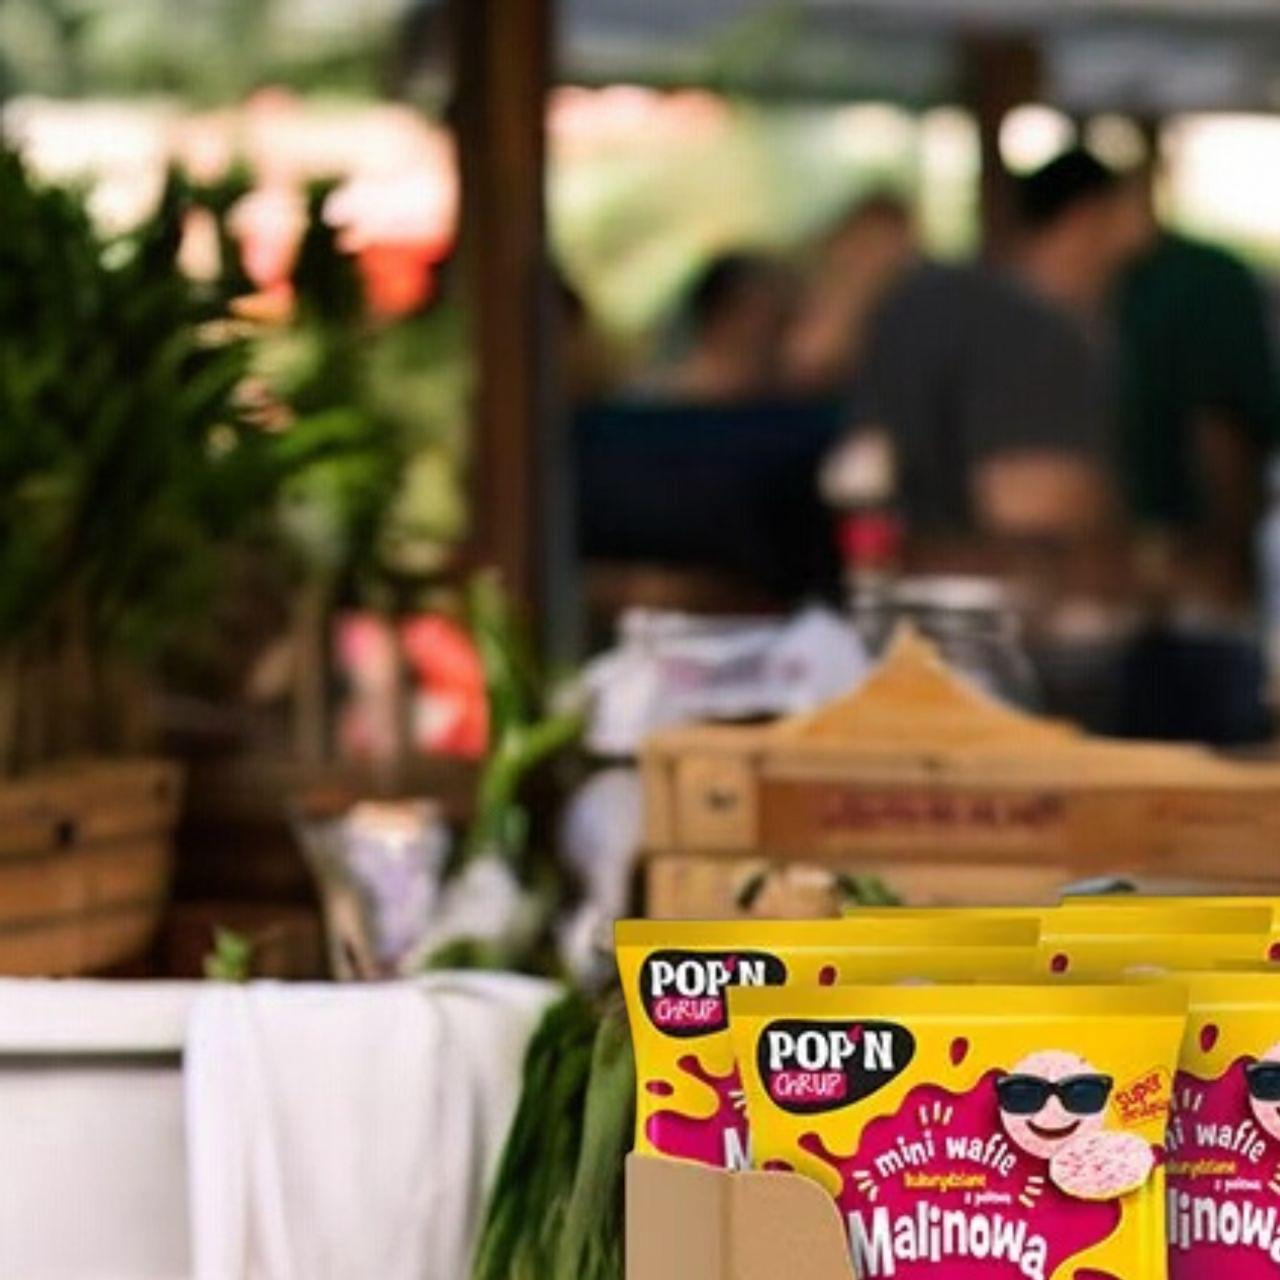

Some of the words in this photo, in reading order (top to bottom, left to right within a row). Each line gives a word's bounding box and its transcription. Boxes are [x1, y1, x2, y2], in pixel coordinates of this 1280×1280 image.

[768, 1025, 895, 1071] POP'N
[874, 1130, 935, 1177] mini
[946, 1134, 1018, 1177] wafle
[1197, 1119, 1267, 1164] wafle
